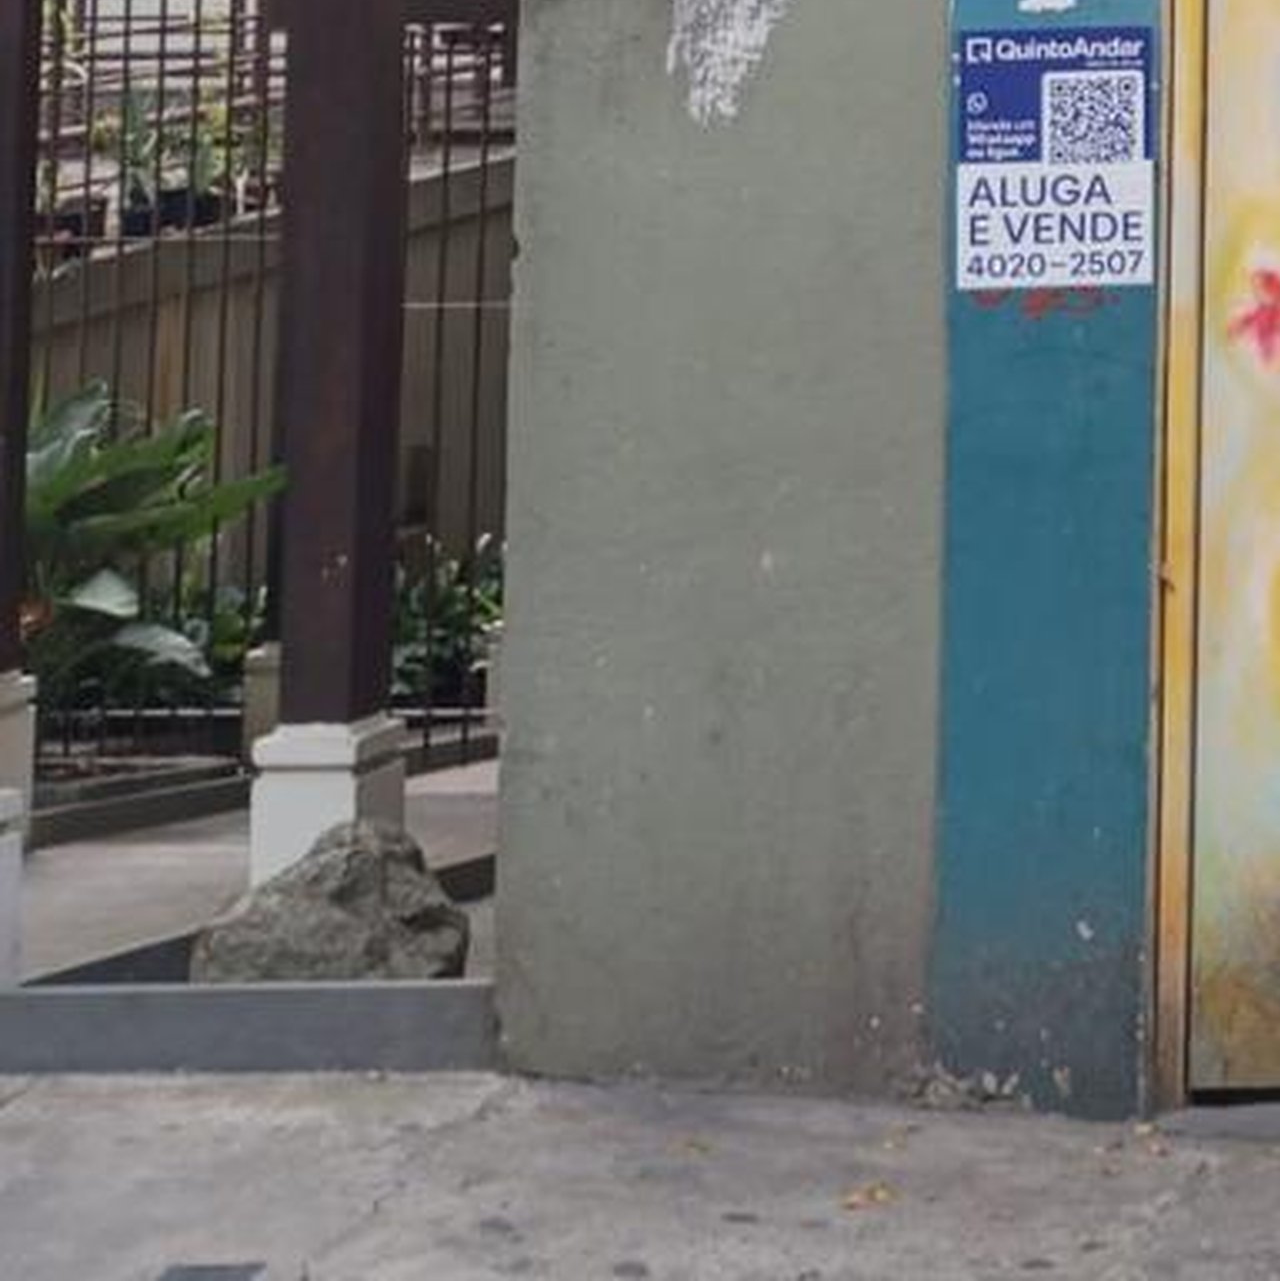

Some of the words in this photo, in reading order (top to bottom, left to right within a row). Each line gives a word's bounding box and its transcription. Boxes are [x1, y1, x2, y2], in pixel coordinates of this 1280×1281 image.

[996, 36, 1144, 61] QuintoAndar
[968, 174, 1112, 208] ALUGA
[969, 215, 990, 246] E
[1003, 211, 1144, 245] VENDE
[966, 250, 1145, 278] 4020-2507
